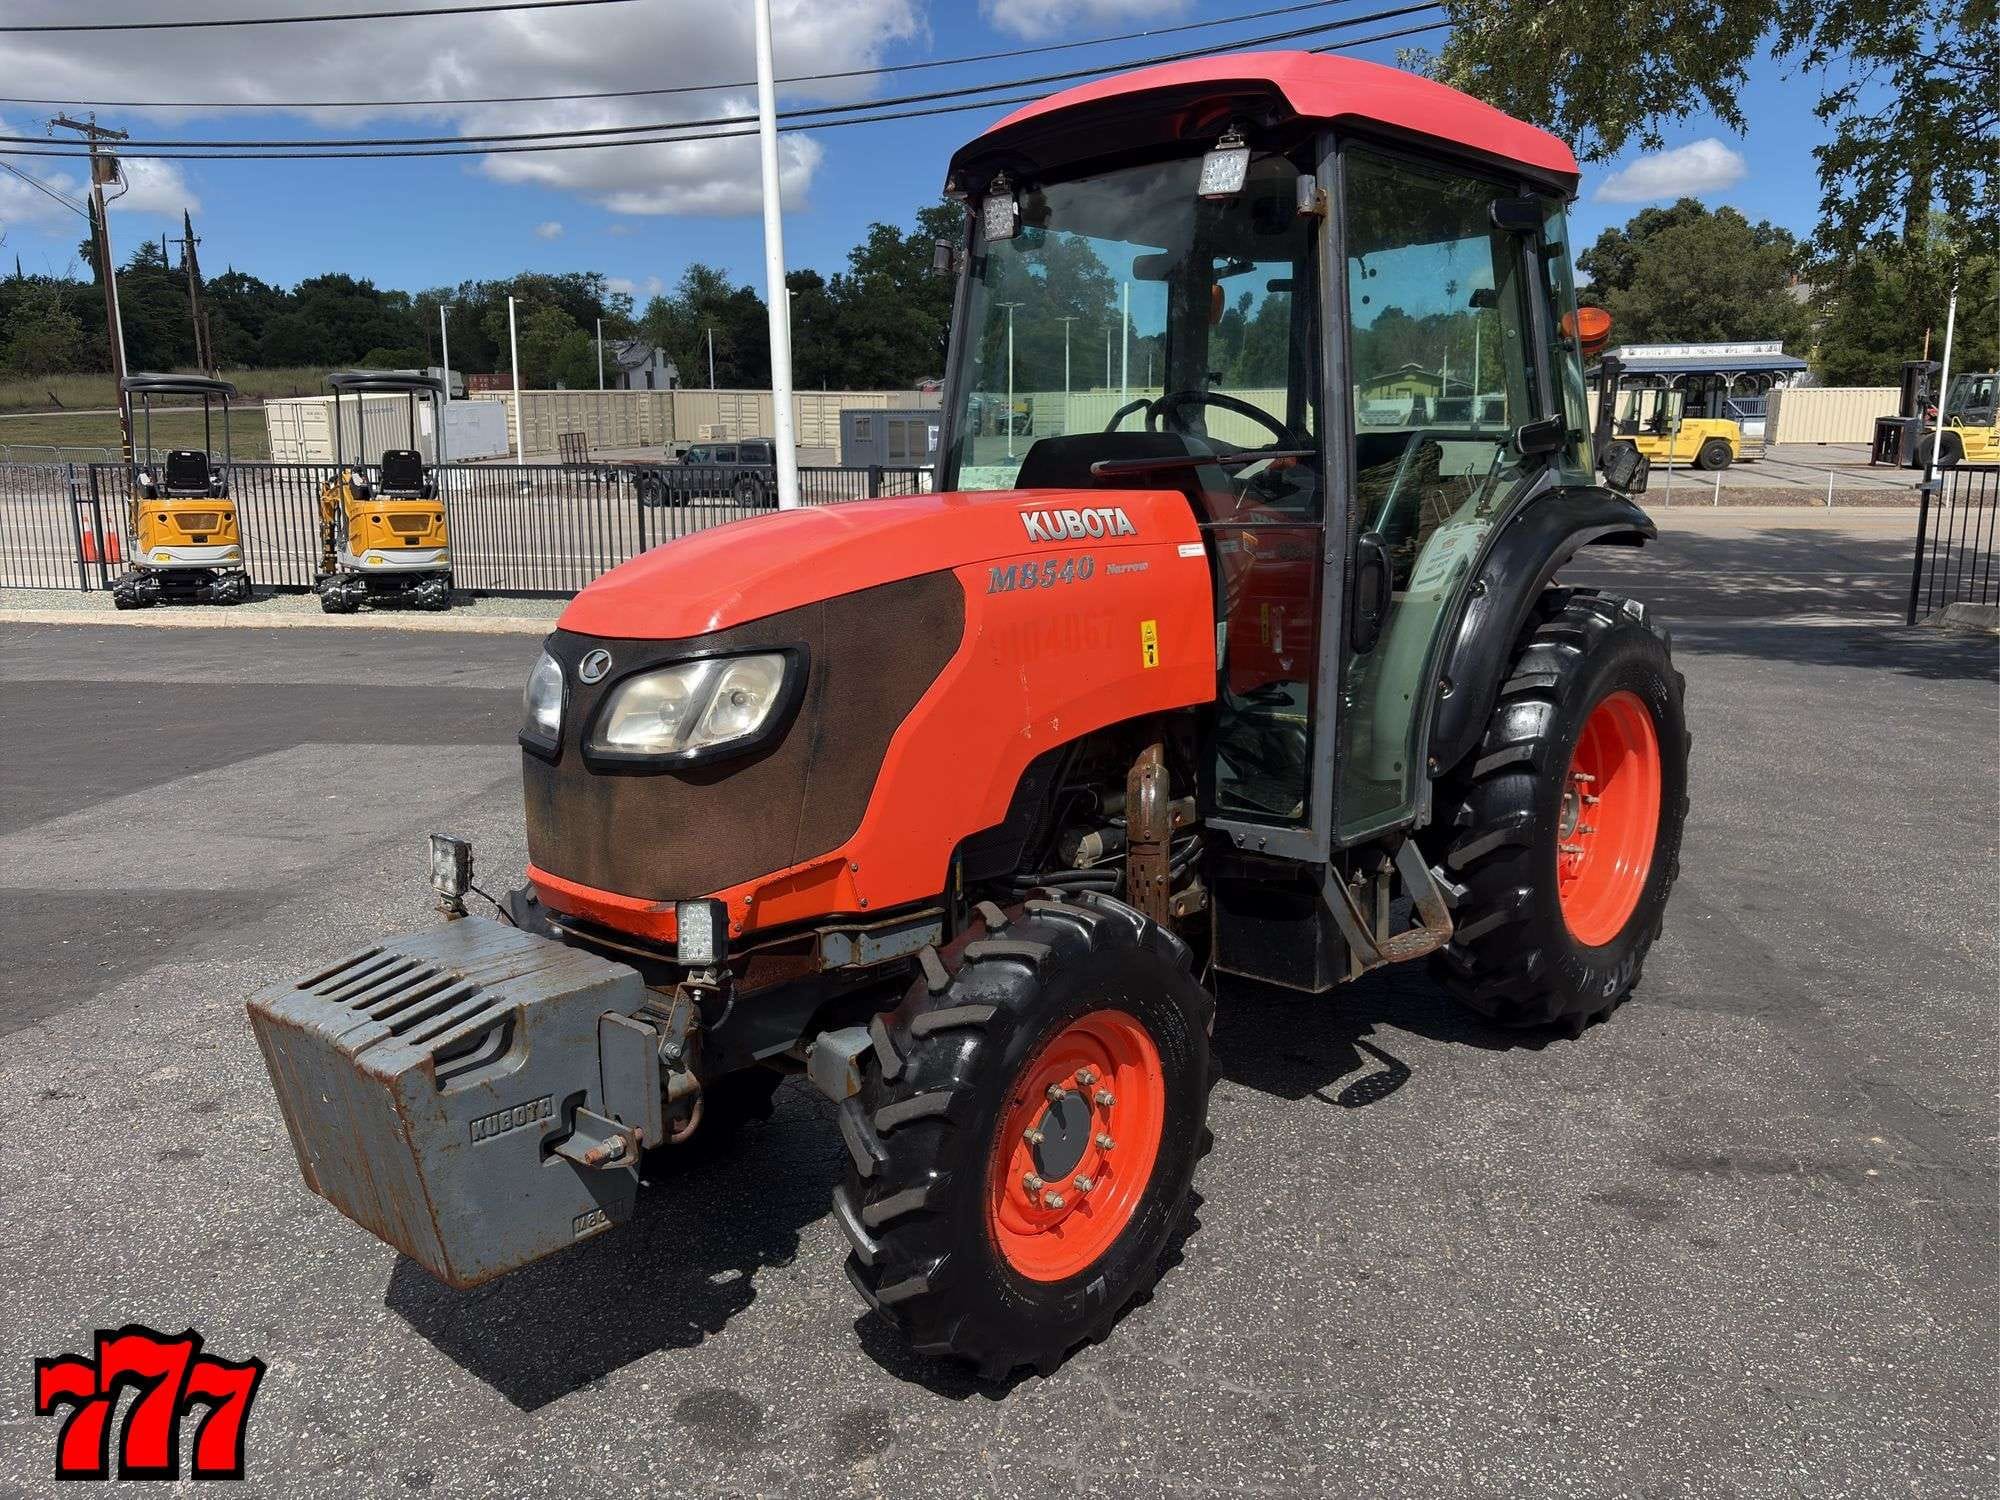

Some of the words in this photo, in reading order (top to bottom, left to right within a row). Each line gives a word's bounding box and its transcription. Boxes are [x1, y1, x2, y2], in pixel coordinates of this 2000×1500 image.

[1019, 507, 1137, 541] KUBOTA
[987, 554, 1095, 594] M8540
[1106, 561, 1149, 575] Narrow
[471, 1097, 554, 1142] KUBOTA
